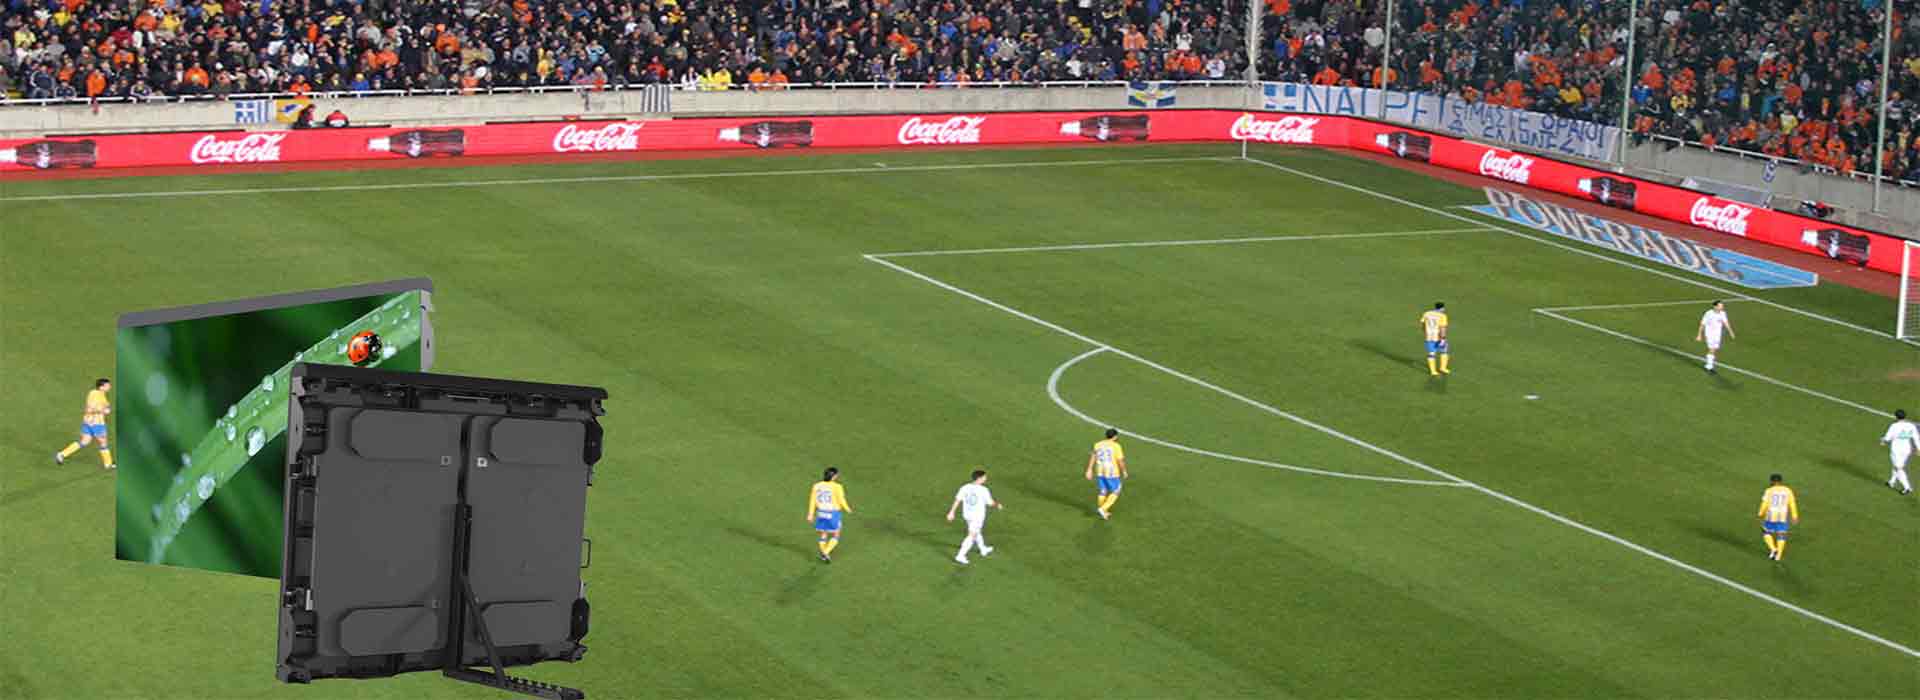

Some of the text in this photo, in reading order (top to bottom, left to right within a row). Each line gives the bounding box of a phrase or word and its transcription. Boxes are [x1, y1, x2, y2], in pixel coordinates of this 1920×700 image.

[553, 122, 644, 152] Coca-Cola
[898, 116, 985, 144] Coca-Cola
[1230, 113, 1320, 144] Coca-Cola
[191, 133, 286, 163] Coca-Cola
[1479, 149, 1533, 184] Coca-Cola
[1483, 186, 1725, 275] POWERADE
[1690, 197, 1752, 236] Coca-Cola
